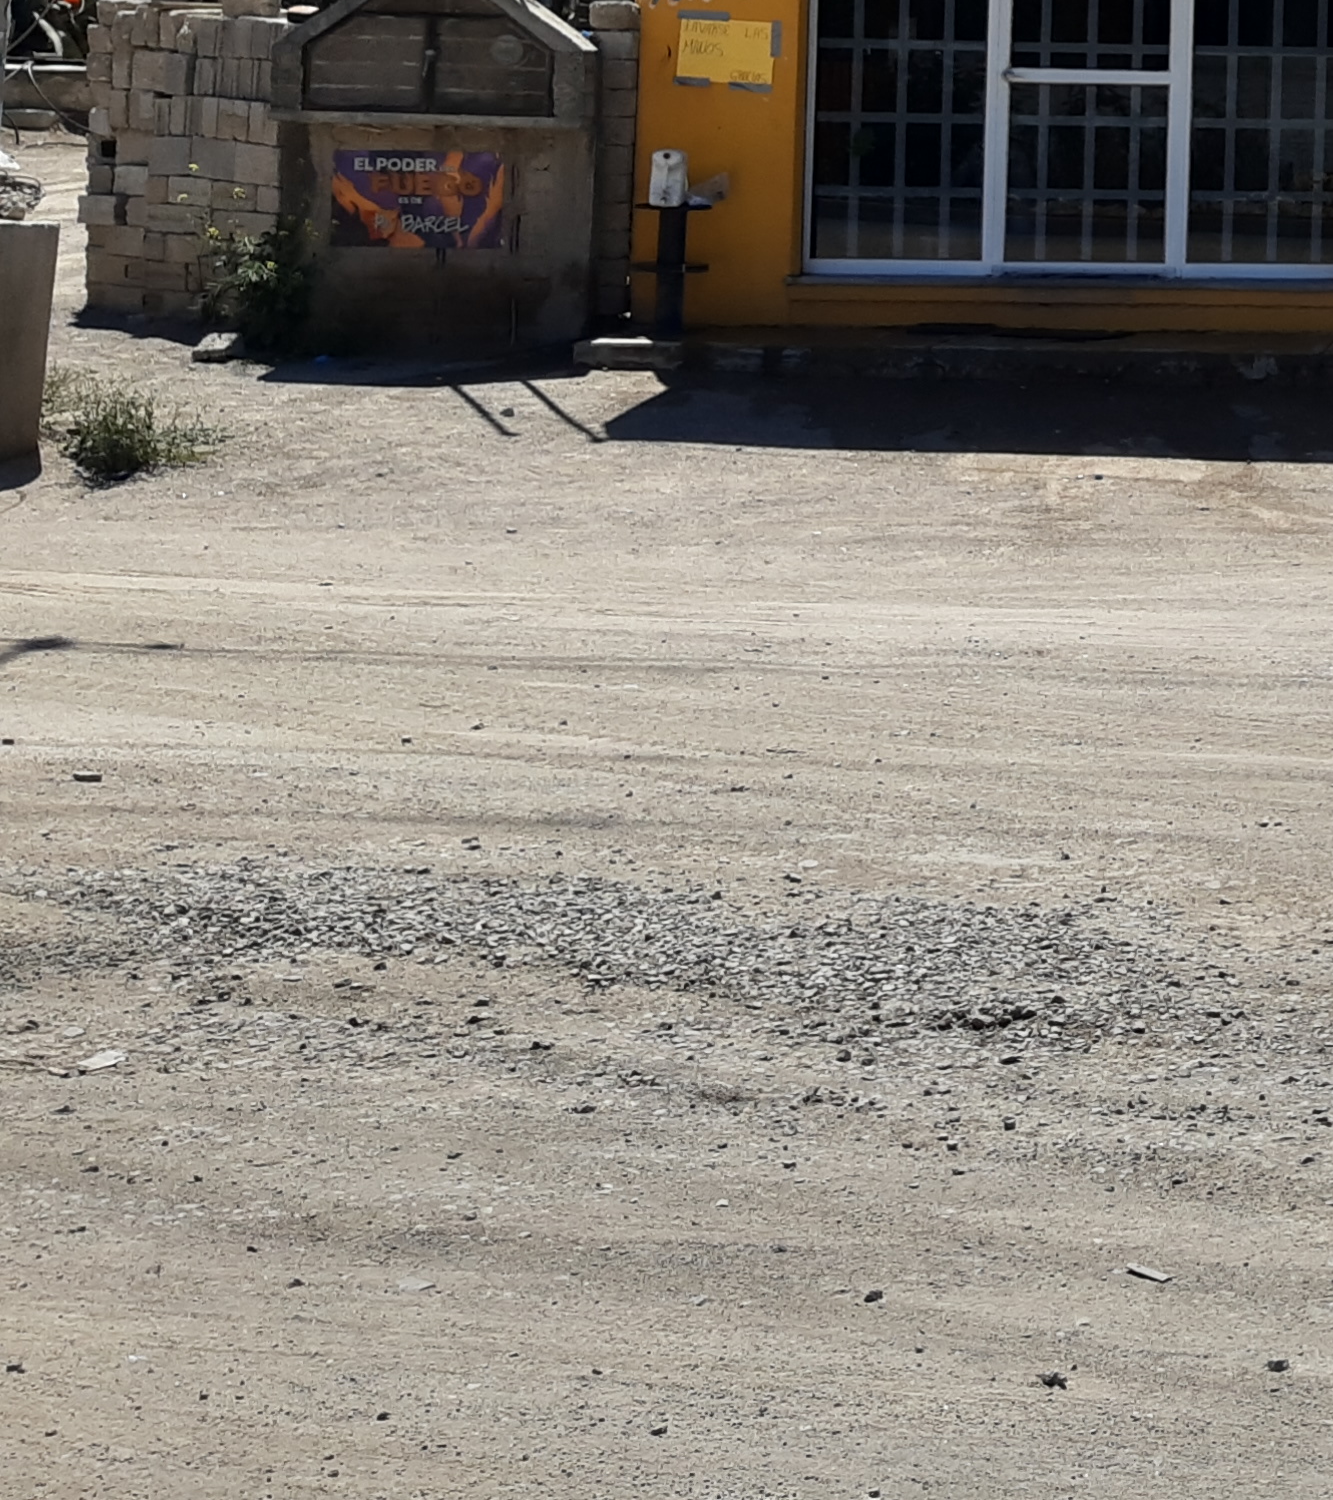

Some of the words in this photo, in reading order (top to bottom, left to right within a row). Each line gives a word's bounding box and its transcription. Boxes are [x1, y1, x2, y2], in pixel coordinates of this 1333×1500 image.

[353, 157, 374, 171] EL
[375, 157, 438, 172] PODER
[400, 213, 471, 234] BARCEL
